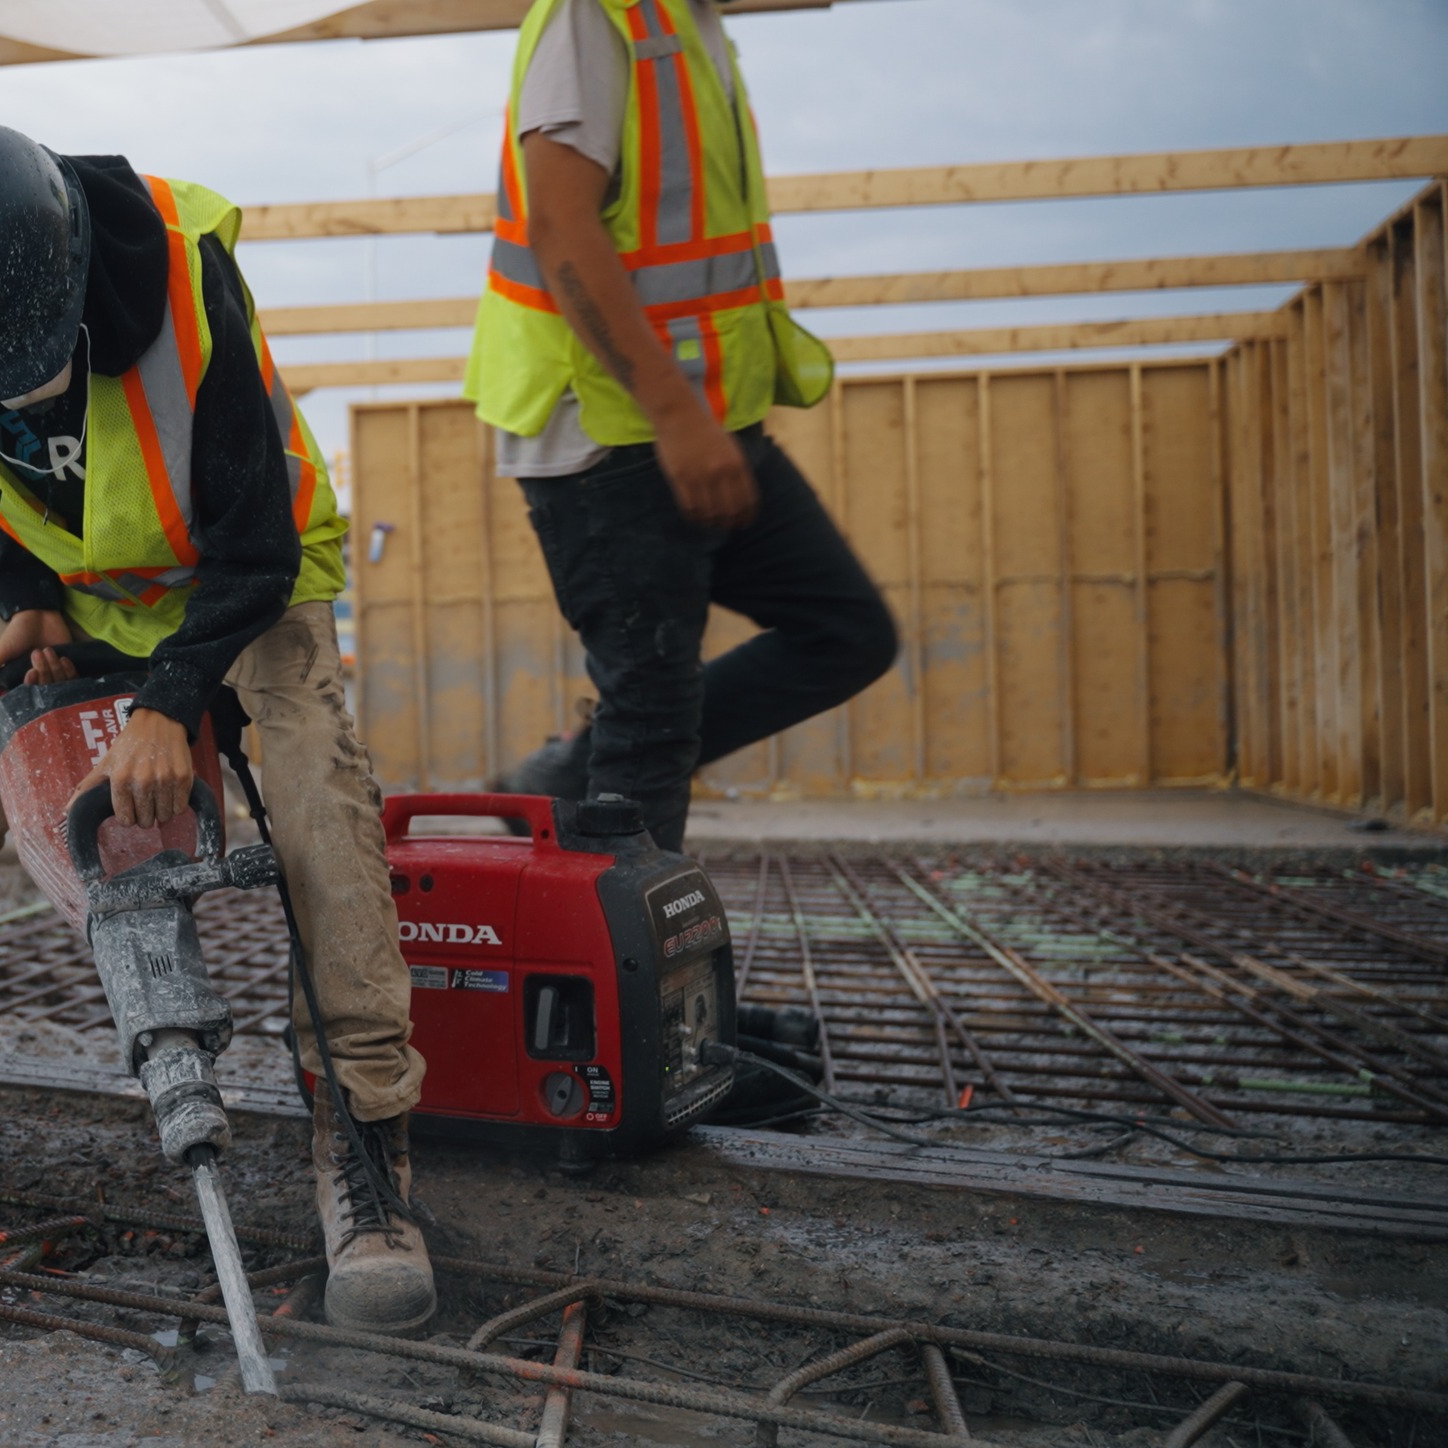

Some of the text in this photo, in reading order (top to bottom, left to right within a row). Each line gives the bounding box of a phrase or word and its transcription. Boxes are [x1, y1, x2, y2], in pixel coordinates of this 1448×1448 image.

[79, 711, 109, 768] LTI
[662, 889, 705, 918] HONDA
[398, 921, 503, 945] ONDA
[464, 982, 507, 991] Technology
